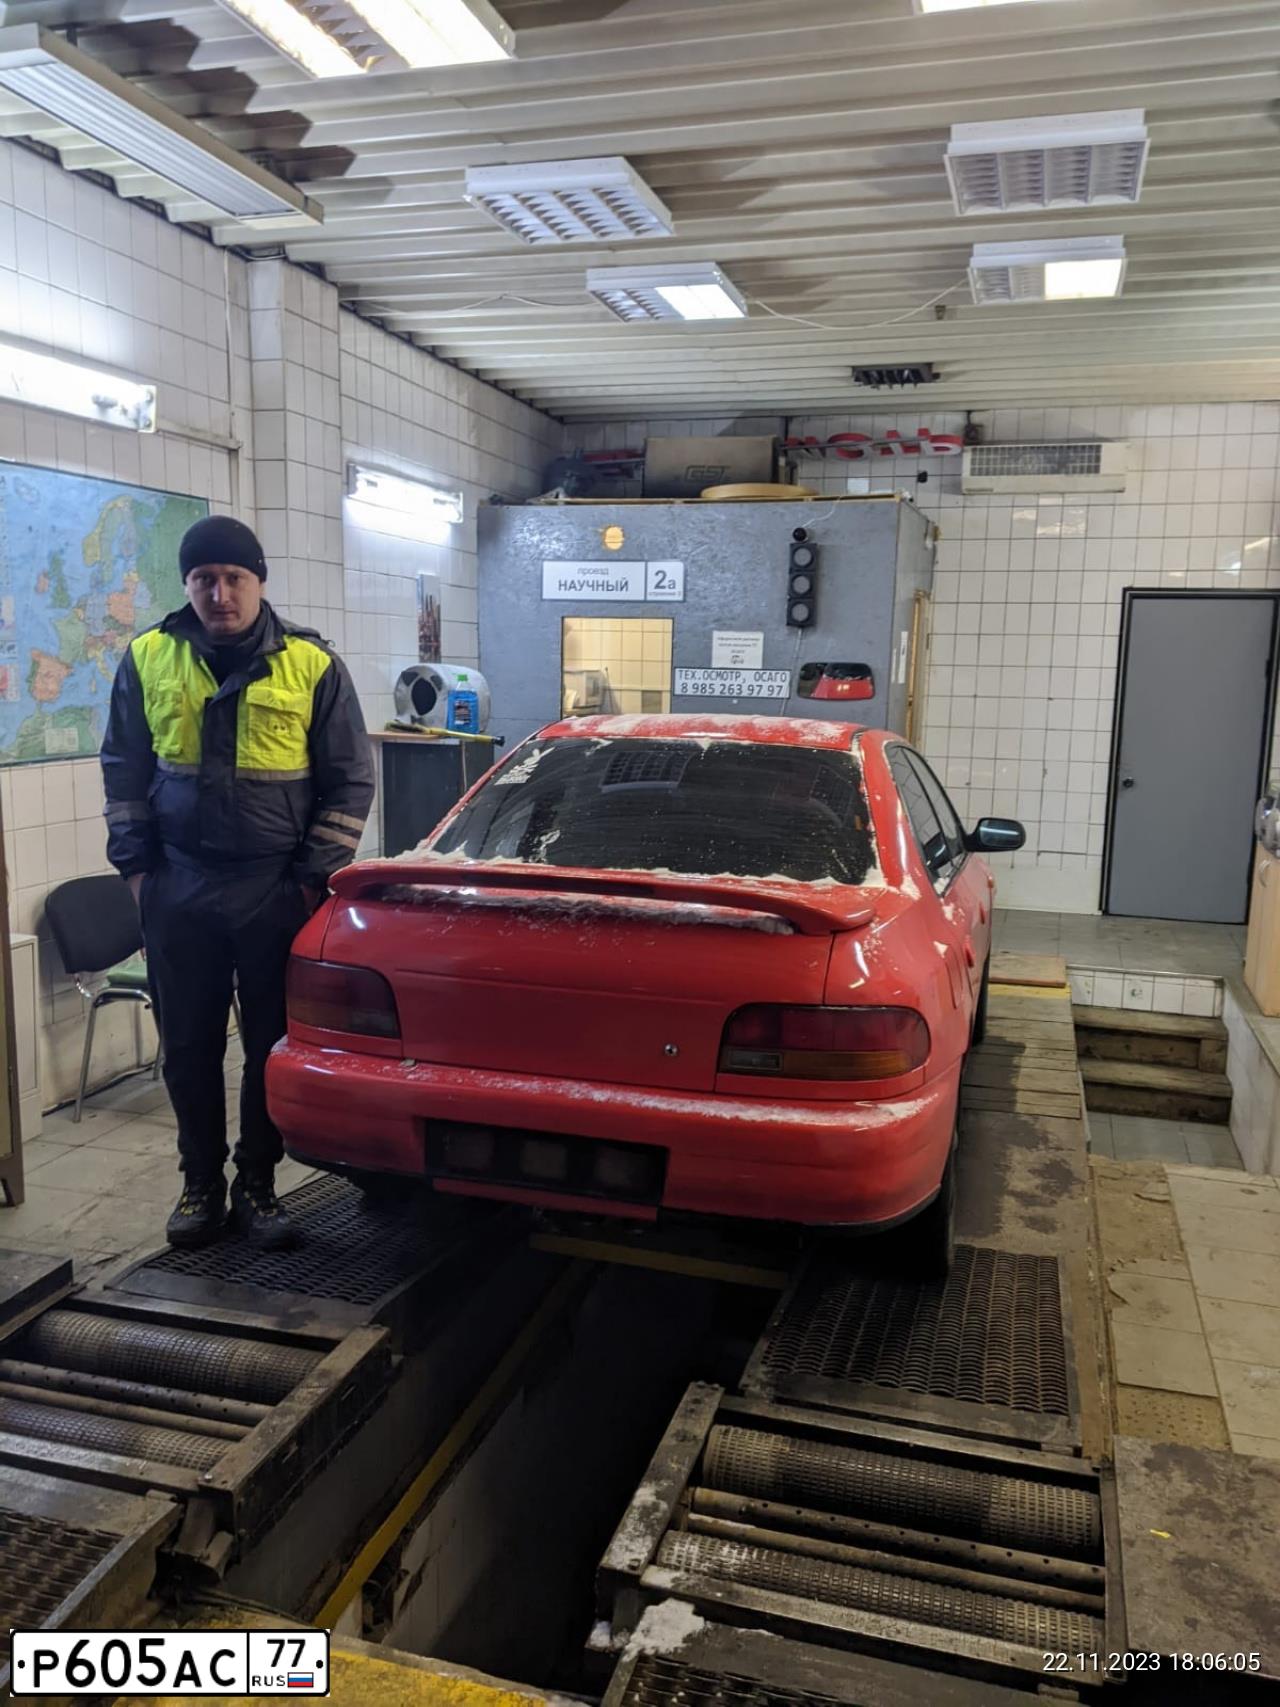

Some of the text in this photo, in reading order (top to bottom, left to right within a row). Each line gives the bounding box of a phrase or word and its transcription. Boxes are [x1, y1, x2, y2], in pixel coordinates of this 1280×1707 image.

[558, 577, 629, 592] НАУЧНЫЙ
[654, 569, 676, 590] 2а
[753, 671, 787, 683] ОСАГО
[681, 682, 784, 697] 8 985 263 97 97
